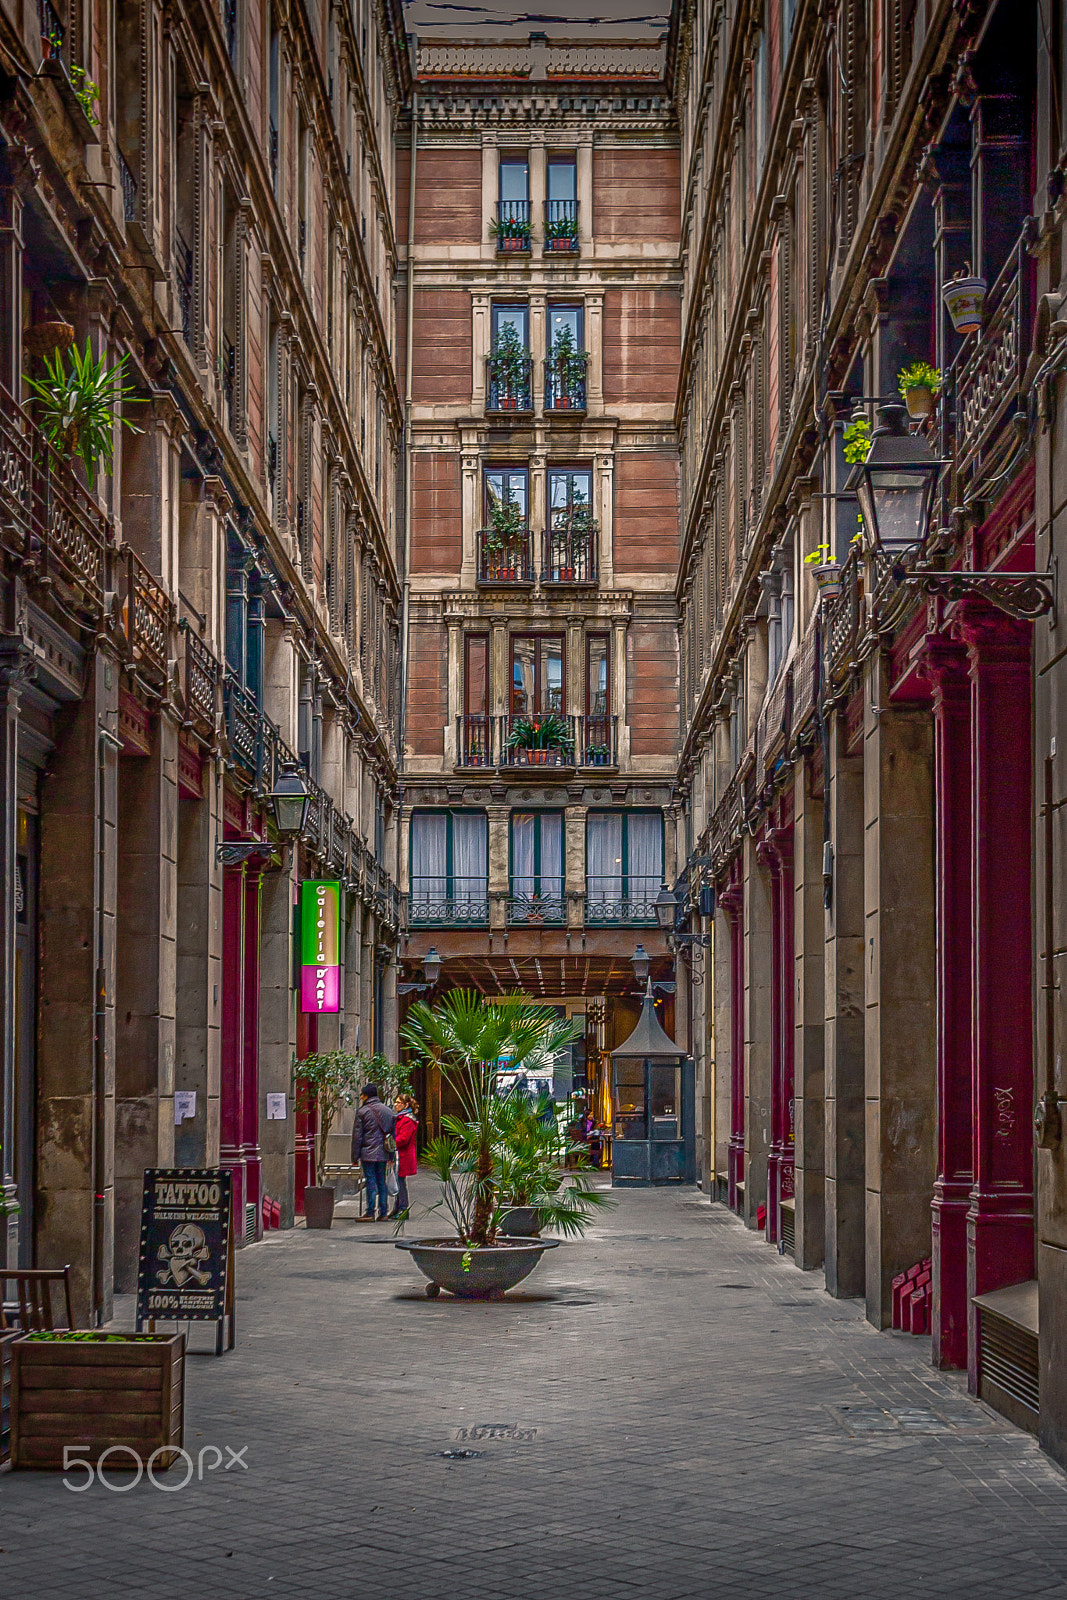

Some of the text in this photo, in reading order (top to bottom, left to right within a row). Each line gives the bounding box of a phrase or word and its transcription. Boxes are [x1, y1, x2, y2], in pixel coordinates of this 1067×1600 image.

[316, 885, 326, 962] Galeria
[155, 1183, 220, 1205] TATTOO
[186, 1212, 220, 1221] WELCOME
[148, 1295, 179, 1309] 100%
